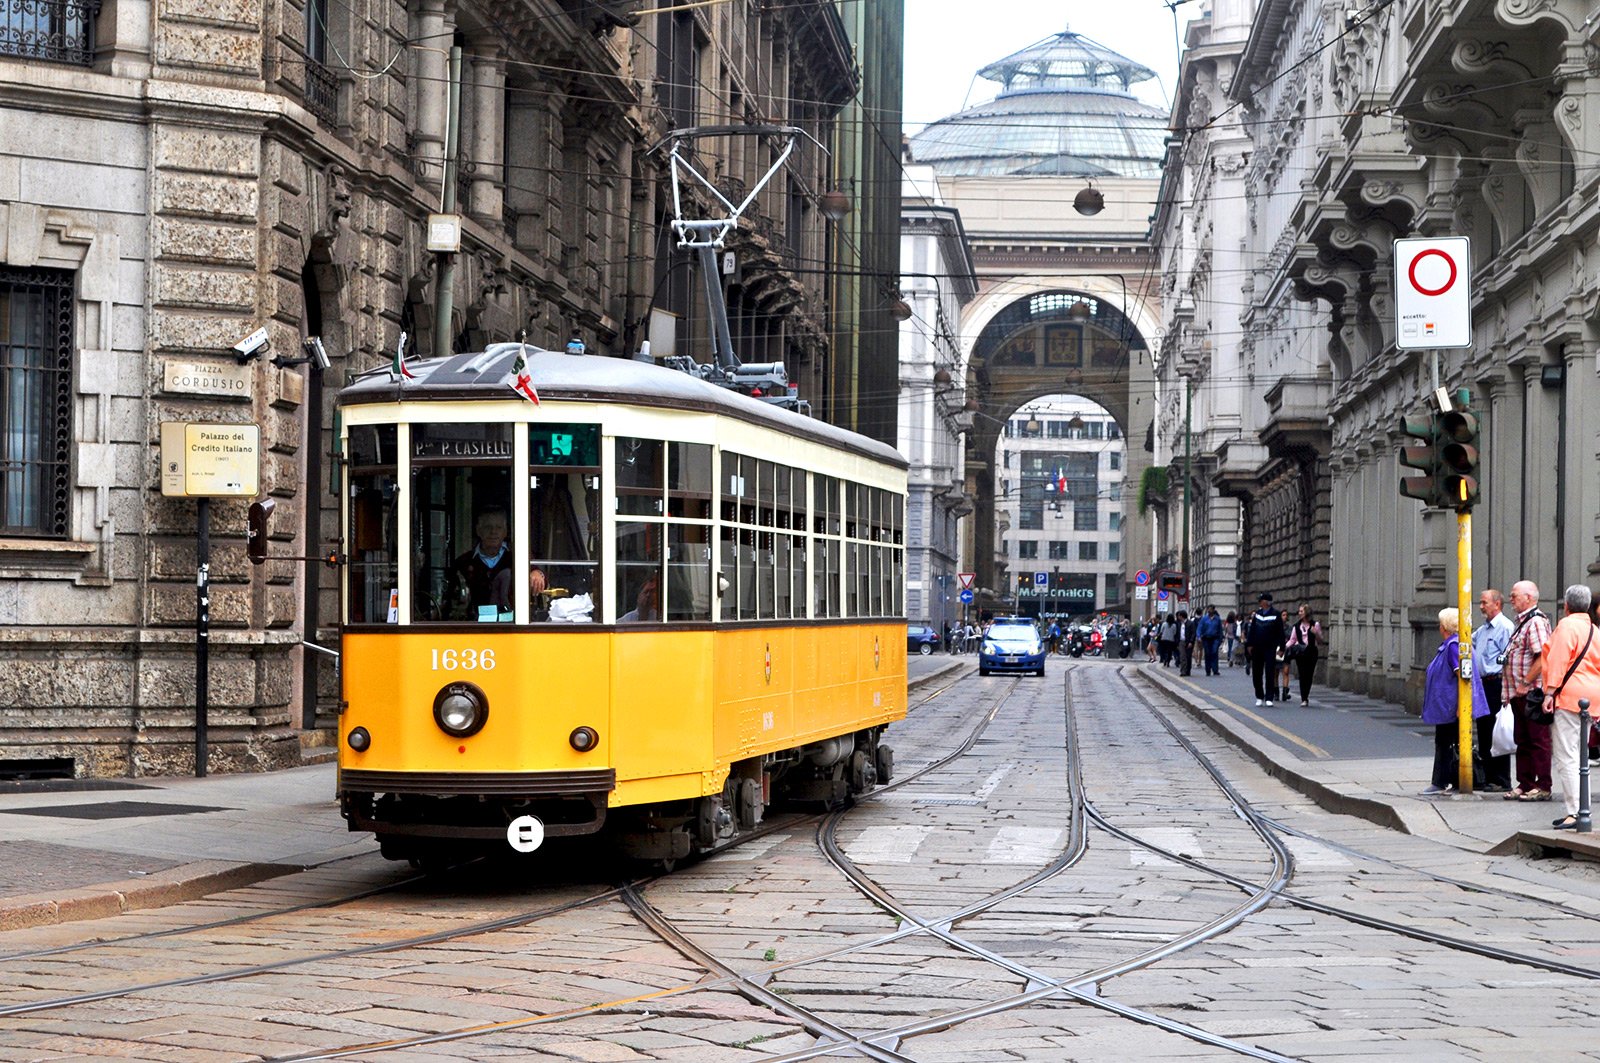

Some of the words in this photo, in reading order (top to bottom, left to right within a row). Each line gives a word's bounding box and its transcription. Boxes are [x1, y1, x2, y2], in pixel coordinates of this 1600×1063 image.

[726, 258, 733, 268] 79
[195, 365, 222, 374] PIAZZA
[172, 376, 244, 390] CORDUSIO
[200, 432, 229, 440] Palazzo
[232, 433, 245, 441] del
[191, 444, 220, 452] Credito
[223, 445, 253, 453] Italiano
[1037, 574, 1045, 583] P
[431, 648, 496, 671] 1636
